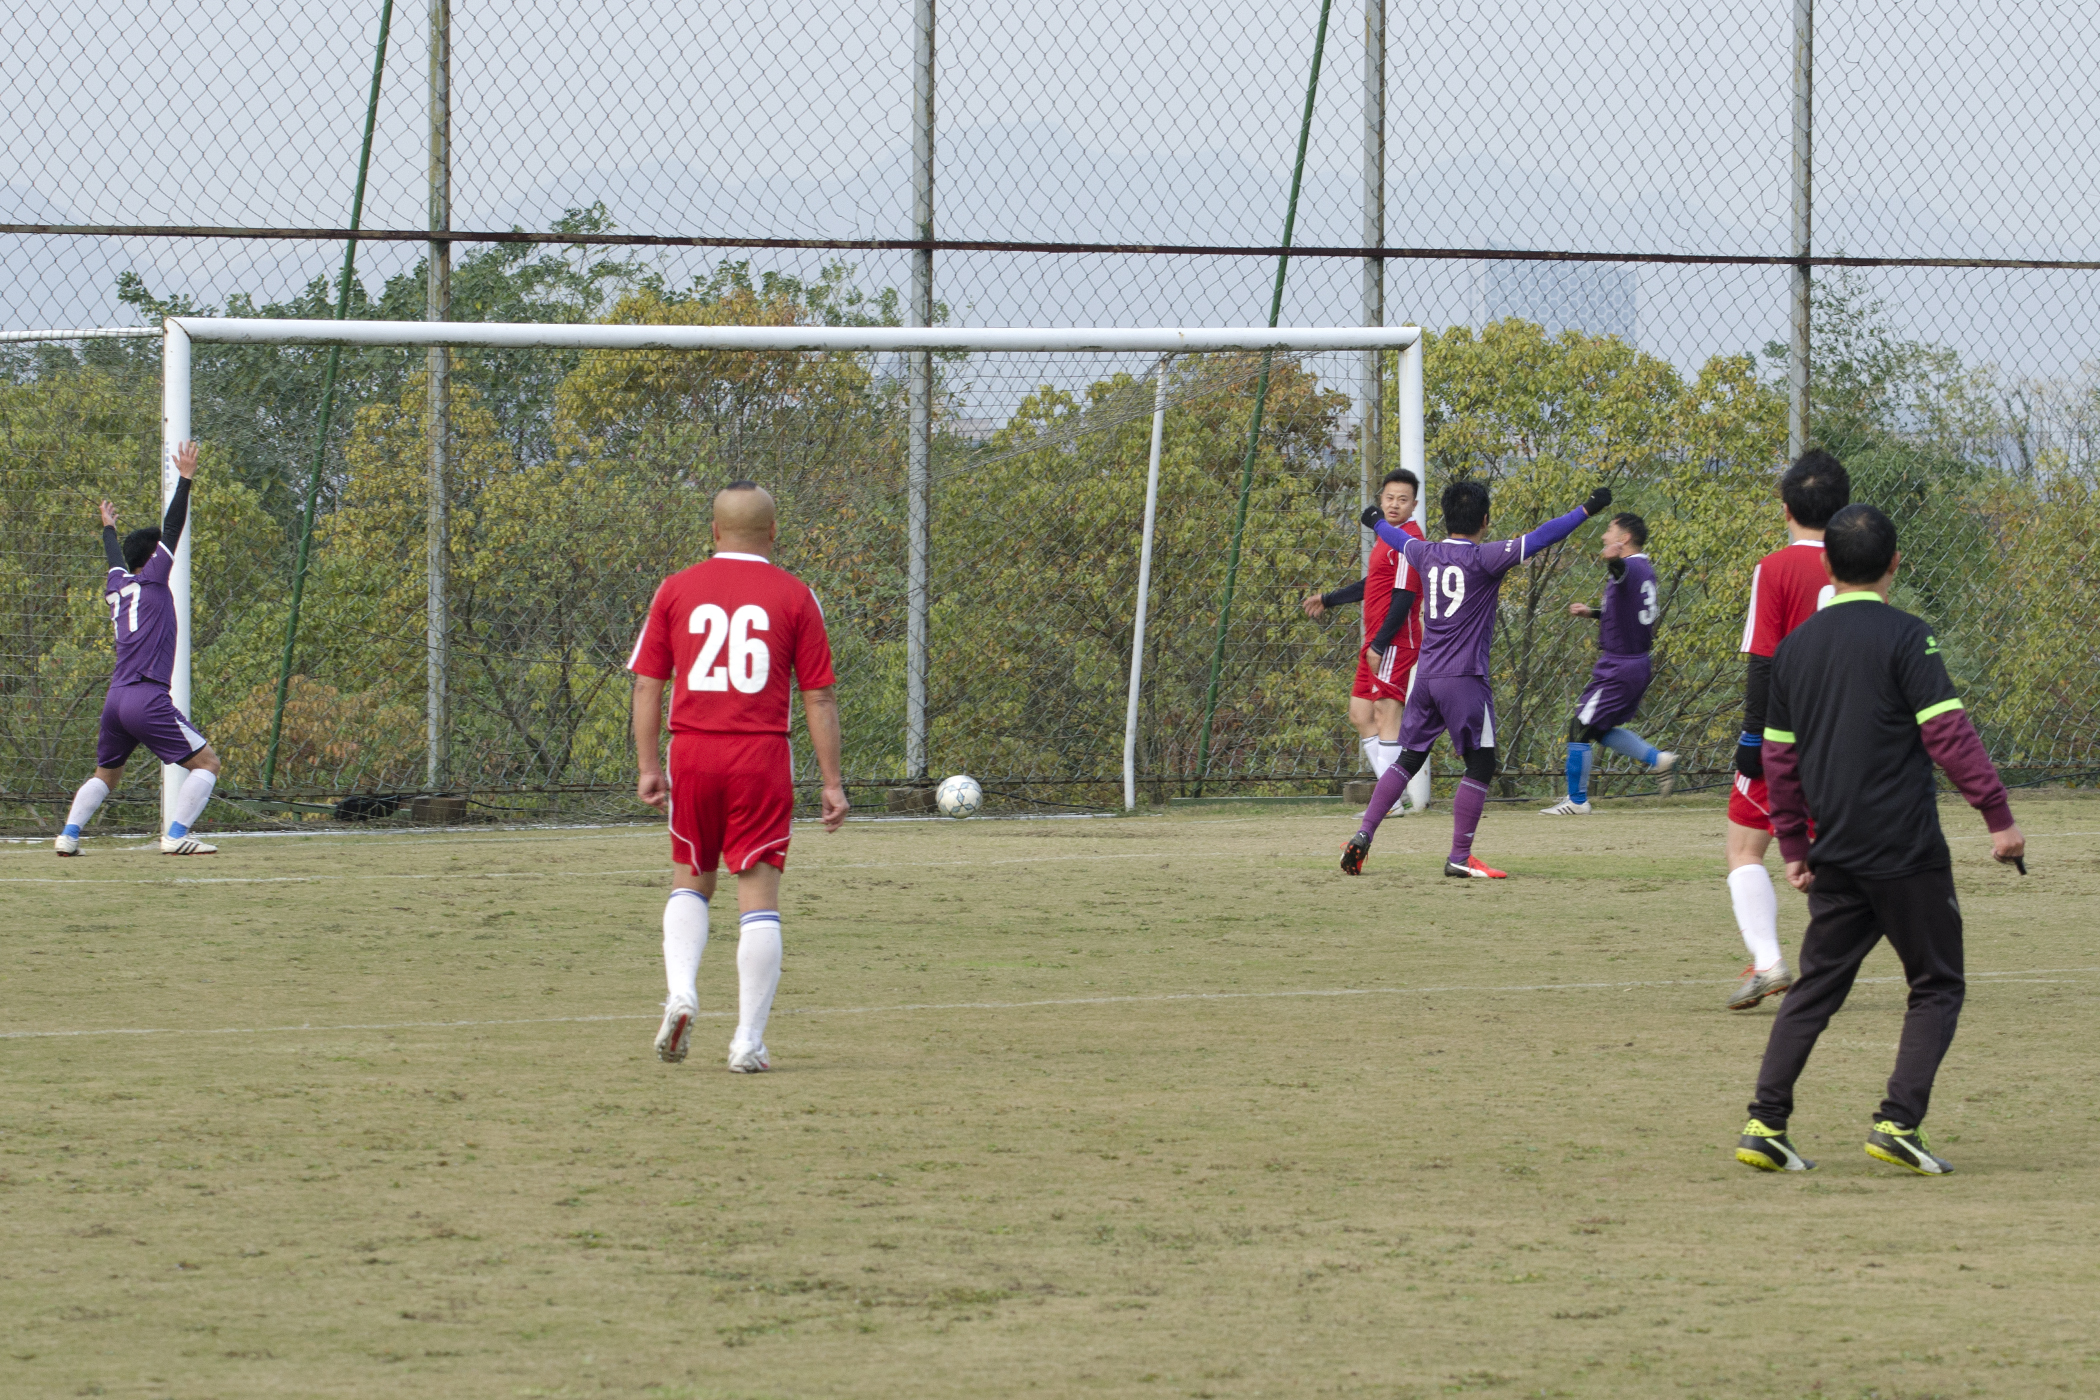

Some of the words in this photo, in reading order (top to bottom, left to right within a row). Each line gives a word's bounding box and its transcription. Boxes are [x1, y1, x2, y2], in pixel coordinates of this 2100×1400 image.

[1428, 565, 1465, 619] 19
[1638, 580, 1659, 625] 3
[688, 603, 770, 694] 26
